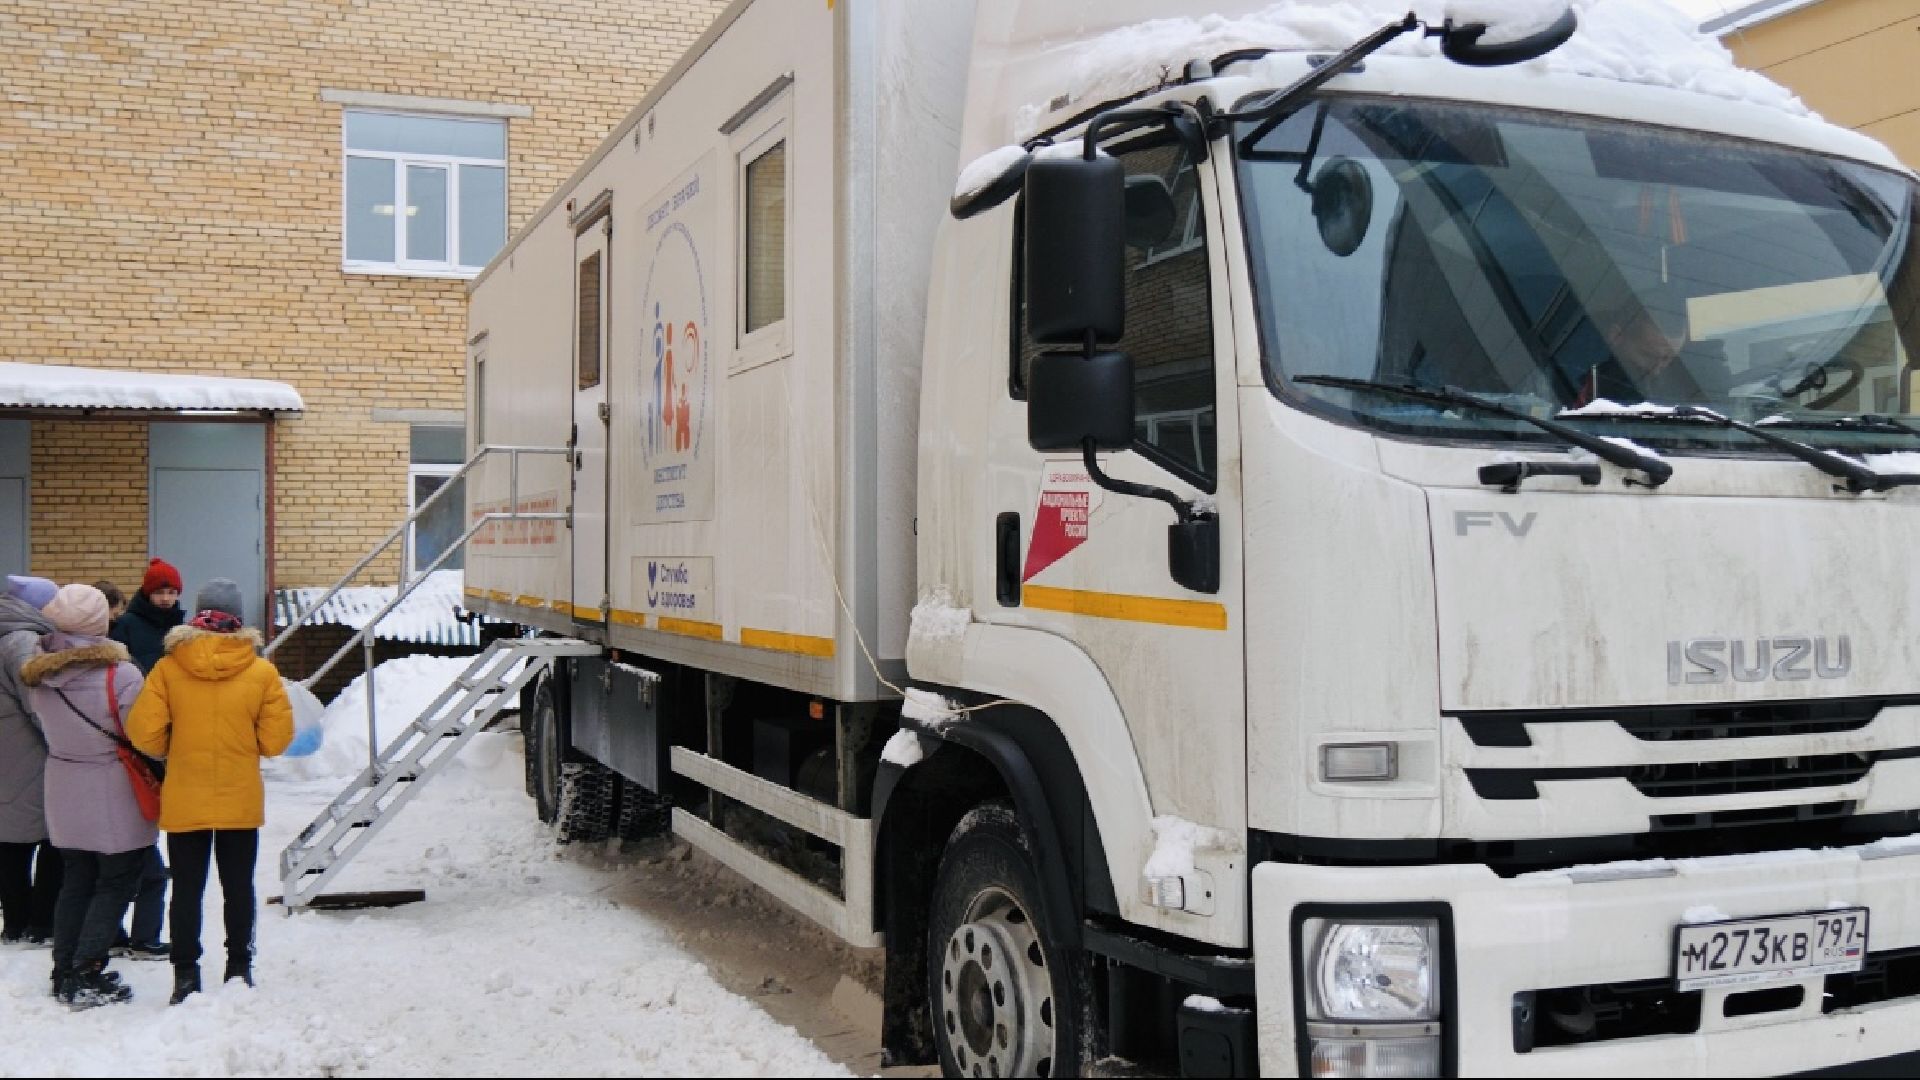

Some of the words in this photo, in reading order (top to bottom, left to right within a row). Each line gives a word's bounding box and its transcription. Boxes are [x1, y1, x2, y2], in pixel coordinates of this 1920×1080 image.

[1454, 511, 1538, 537] FV
[661, 562, 688, 587] Служба
[660, 591, 696, 612] здоровья
[1666, 634, 1852, 686] ISUZU
[1817, 916, 1857, 948] 797
[1824, 947, 1845, 959] RUS
